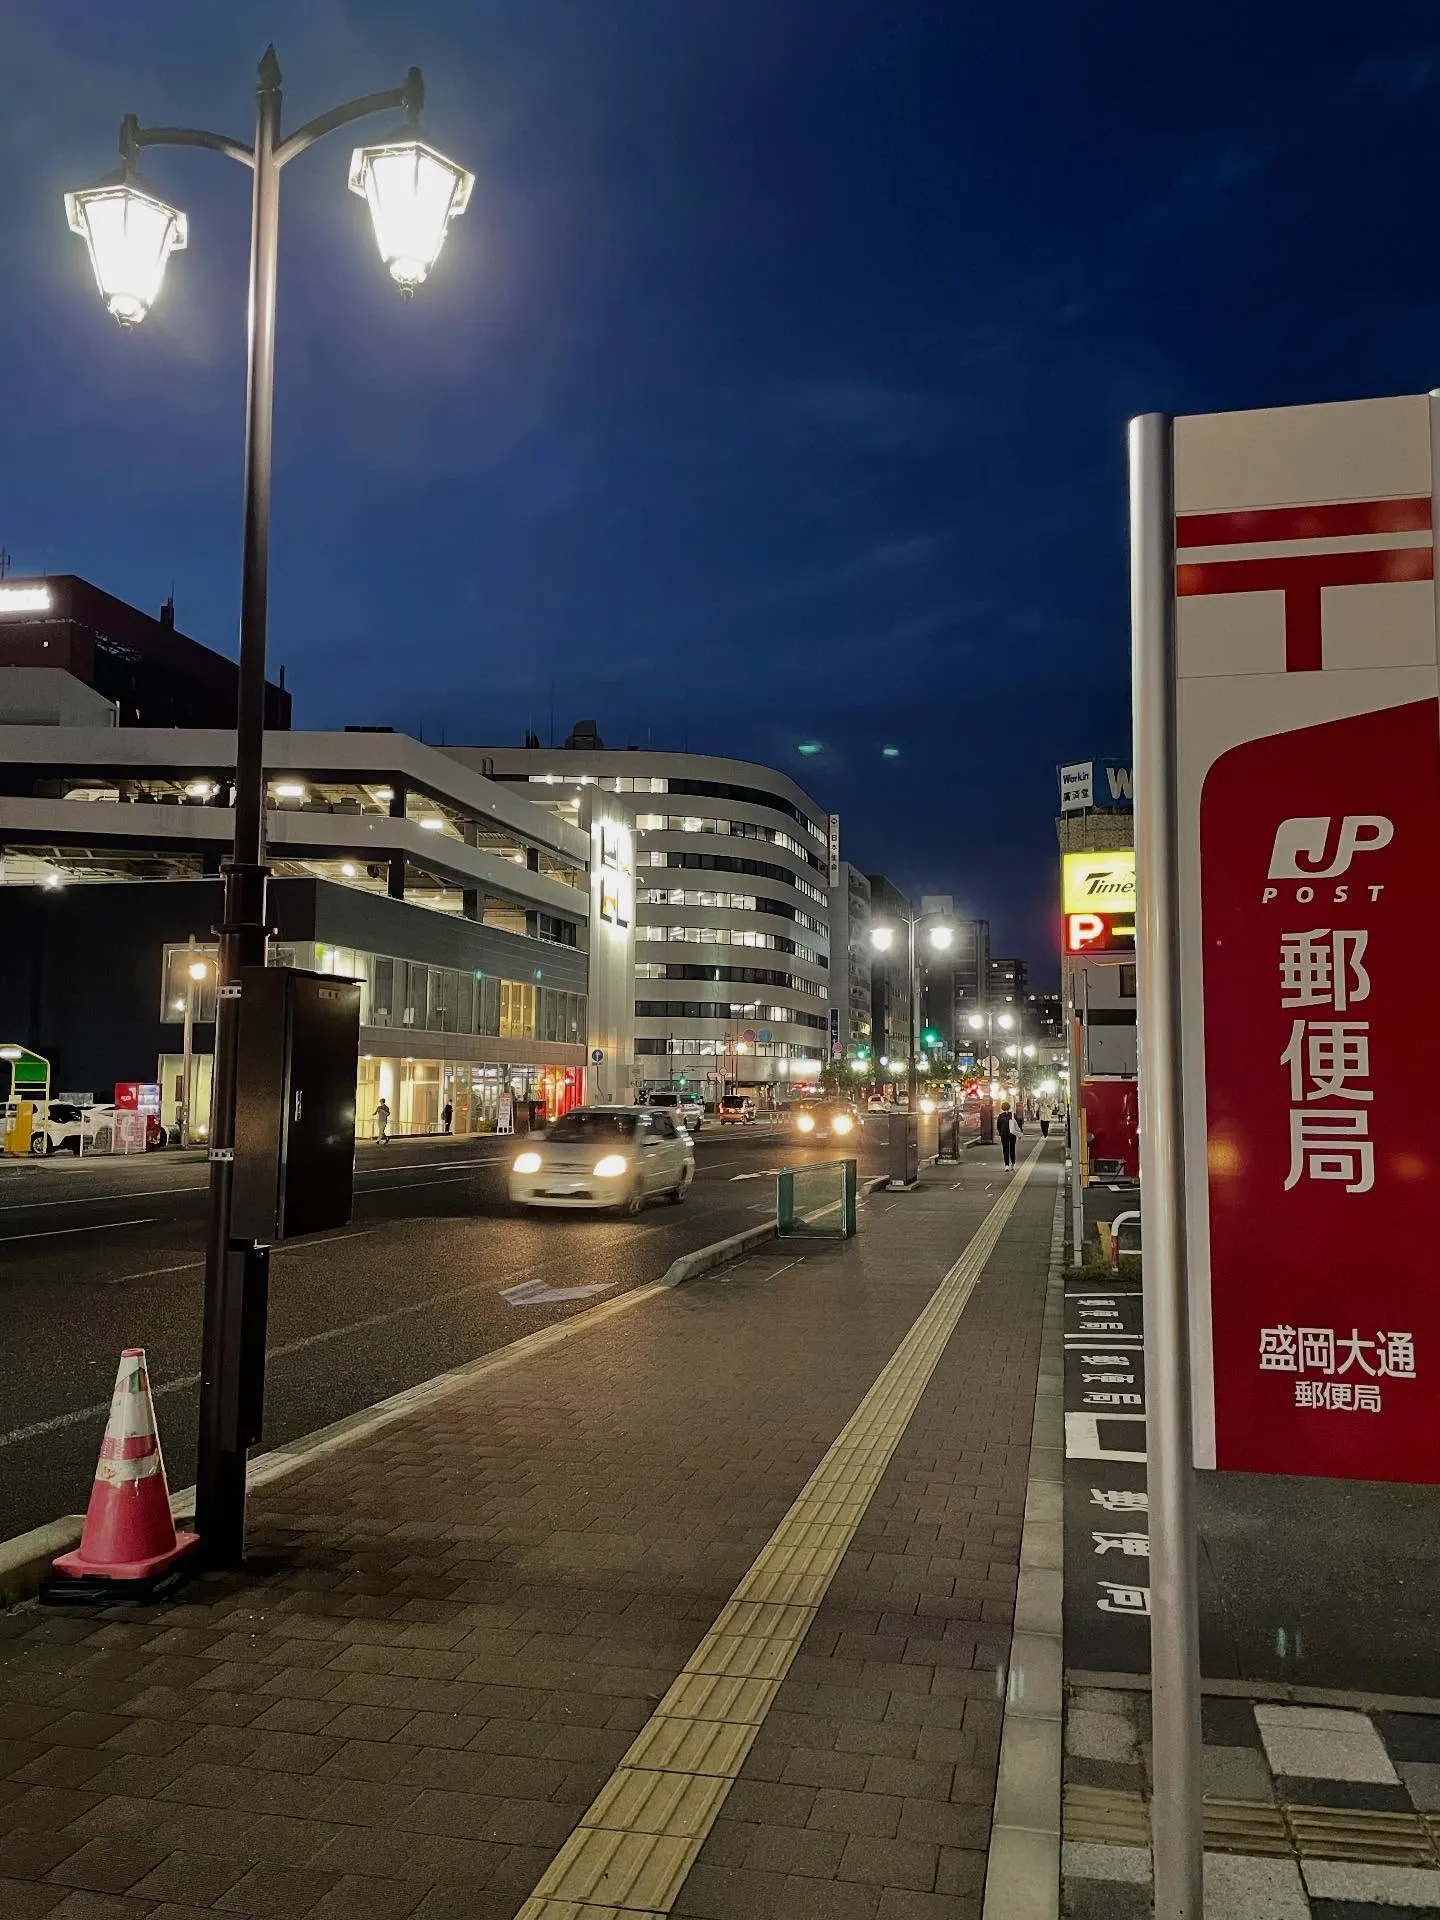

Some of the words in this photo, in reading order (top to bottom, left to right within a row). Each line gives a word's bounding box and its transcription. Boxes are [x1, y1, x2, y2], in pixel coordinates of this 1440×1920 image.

[1063, 772, 1089, 784] Workin
[1267, 815, 1395, 880] JP
[1085, 872, 1136, 895] Time
[1262, 885, 1385, 904] POST
[1279, 928, 1376, 1194] 郵便局
[1259, 1325, 1417, 1379] 盛岡大通
[1295, 1381, 1382, 1413] 郵便局
